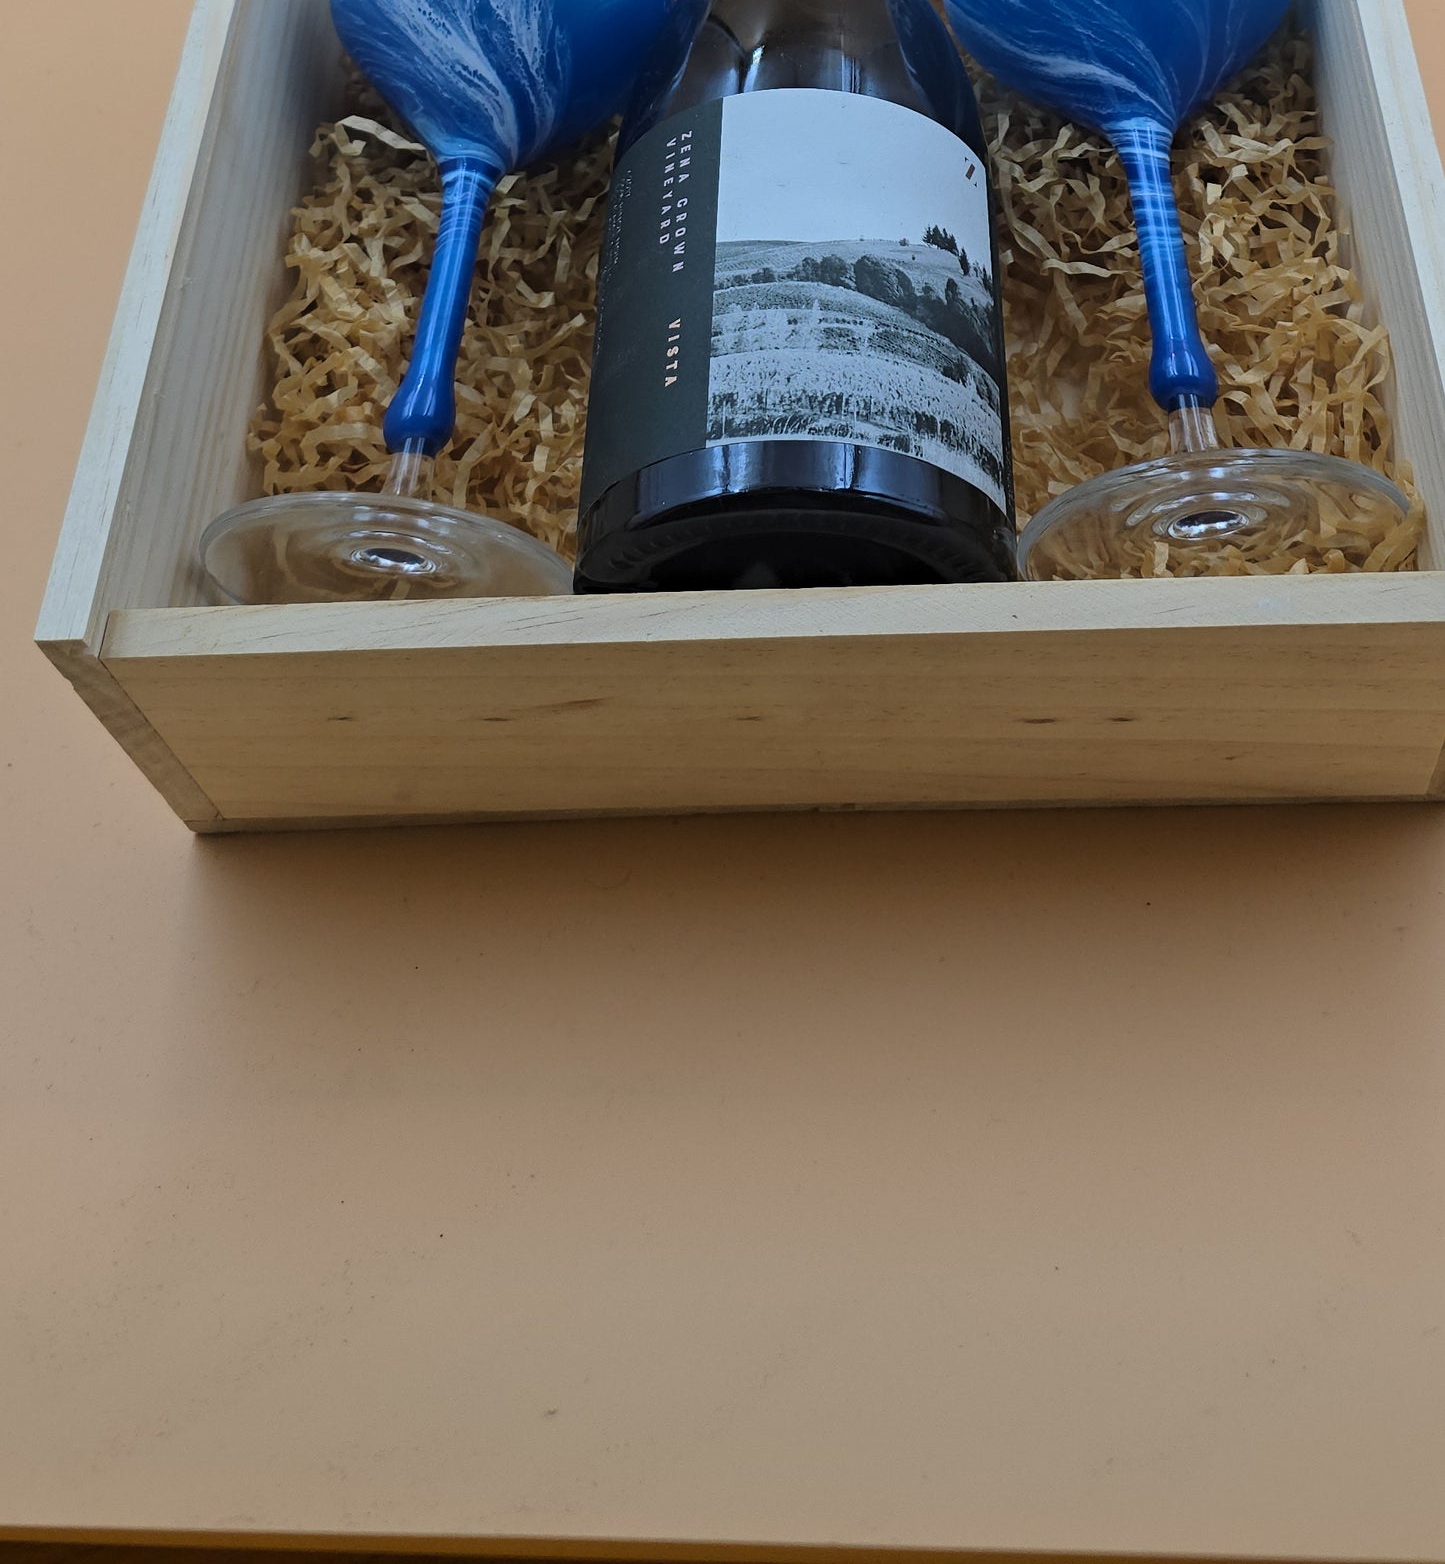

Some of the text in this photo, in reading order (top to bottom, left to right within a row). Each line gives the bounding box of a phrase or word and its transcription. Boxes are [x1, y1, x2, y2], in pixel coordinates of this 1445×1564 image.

[659, 137, 677, 245] VINEYARD
[672, 130, 693, 273] ZENA CROWN
[664, 317, 681, 388] VISTA
